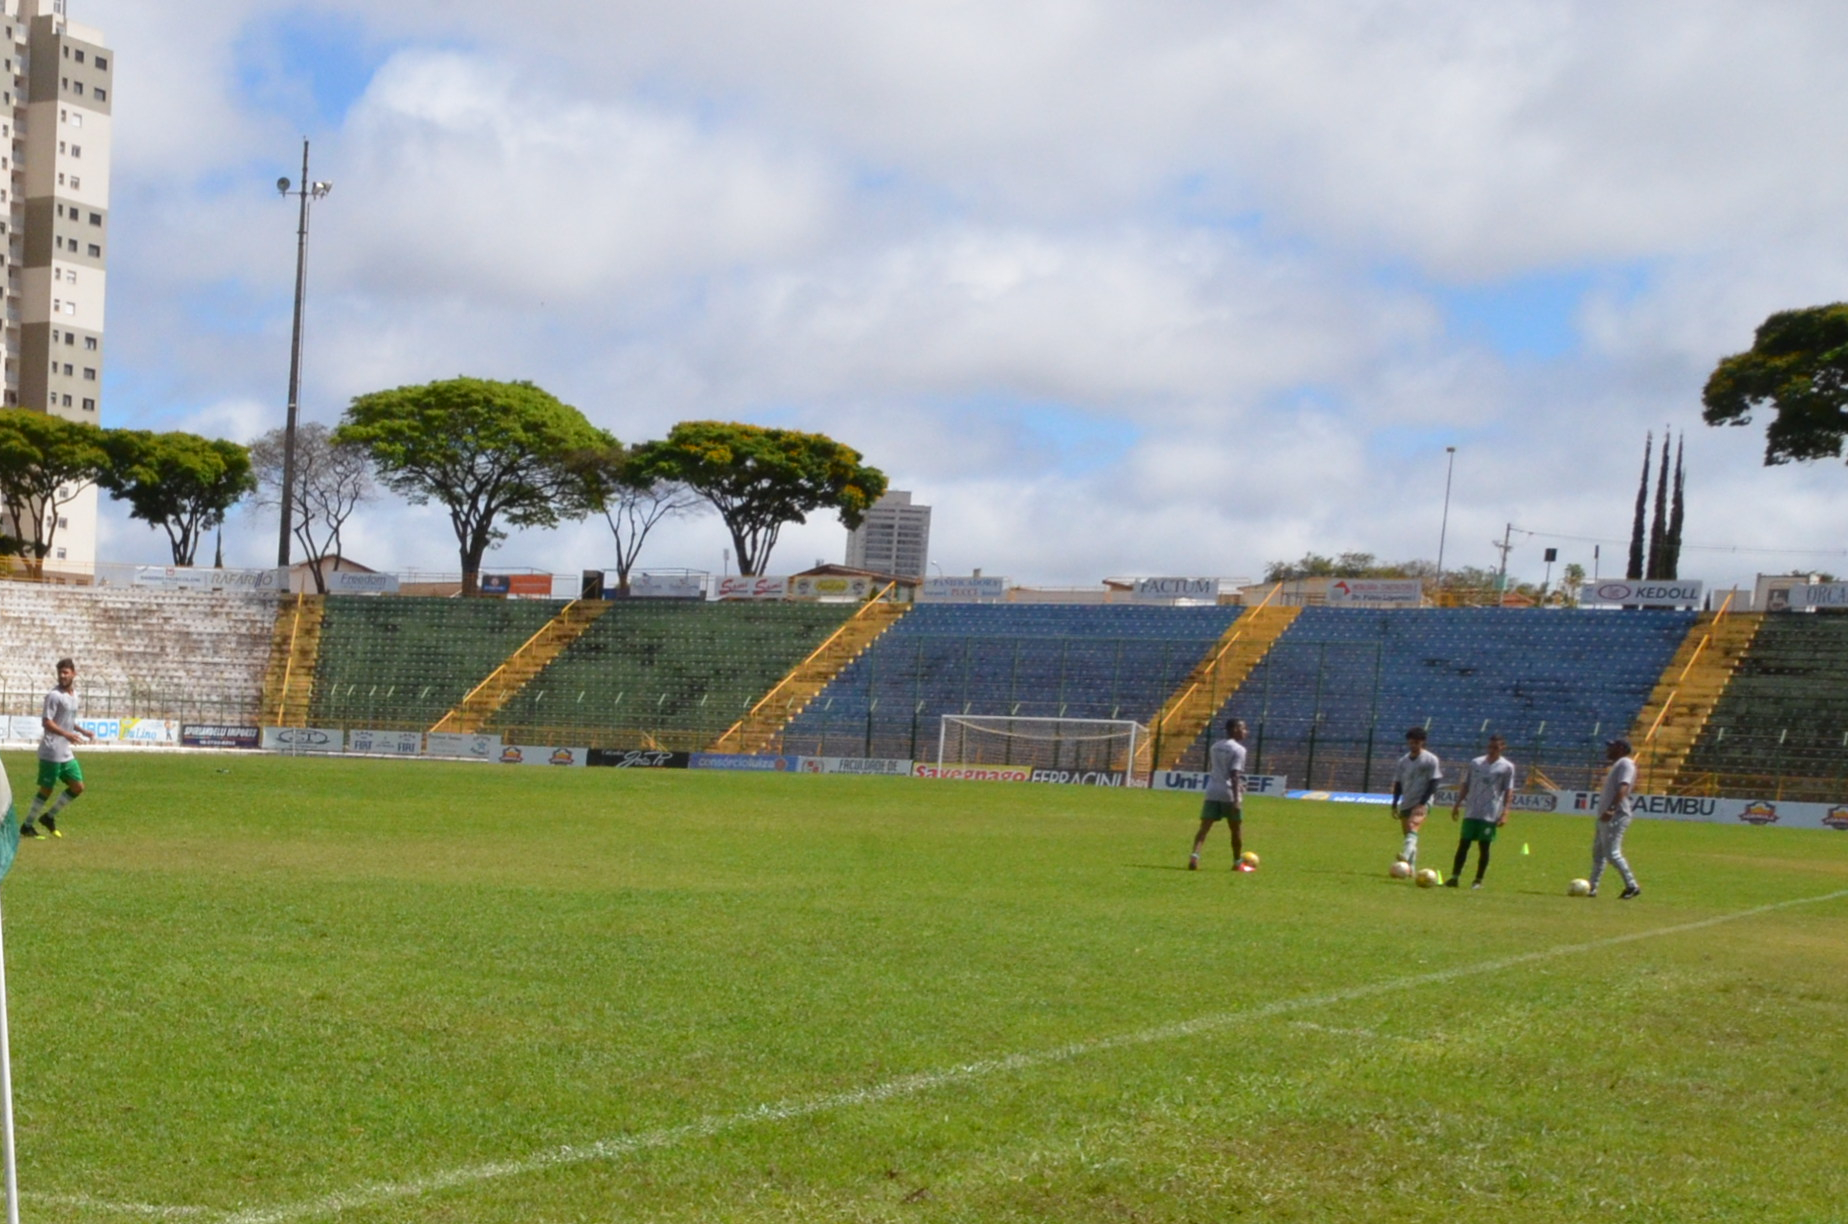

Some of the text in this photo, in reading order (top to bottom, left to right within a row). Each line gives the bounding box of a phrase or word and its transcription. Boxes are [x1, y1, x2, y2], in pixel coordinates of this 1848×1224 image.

[1140, 578, 1211, 594] FACTUM
[1635, 584, 1698, 600] KEDOLL
[839, 759, 898, 772] FACULDADE DE
[1032, 769, 1122, 788] FERRACINI
